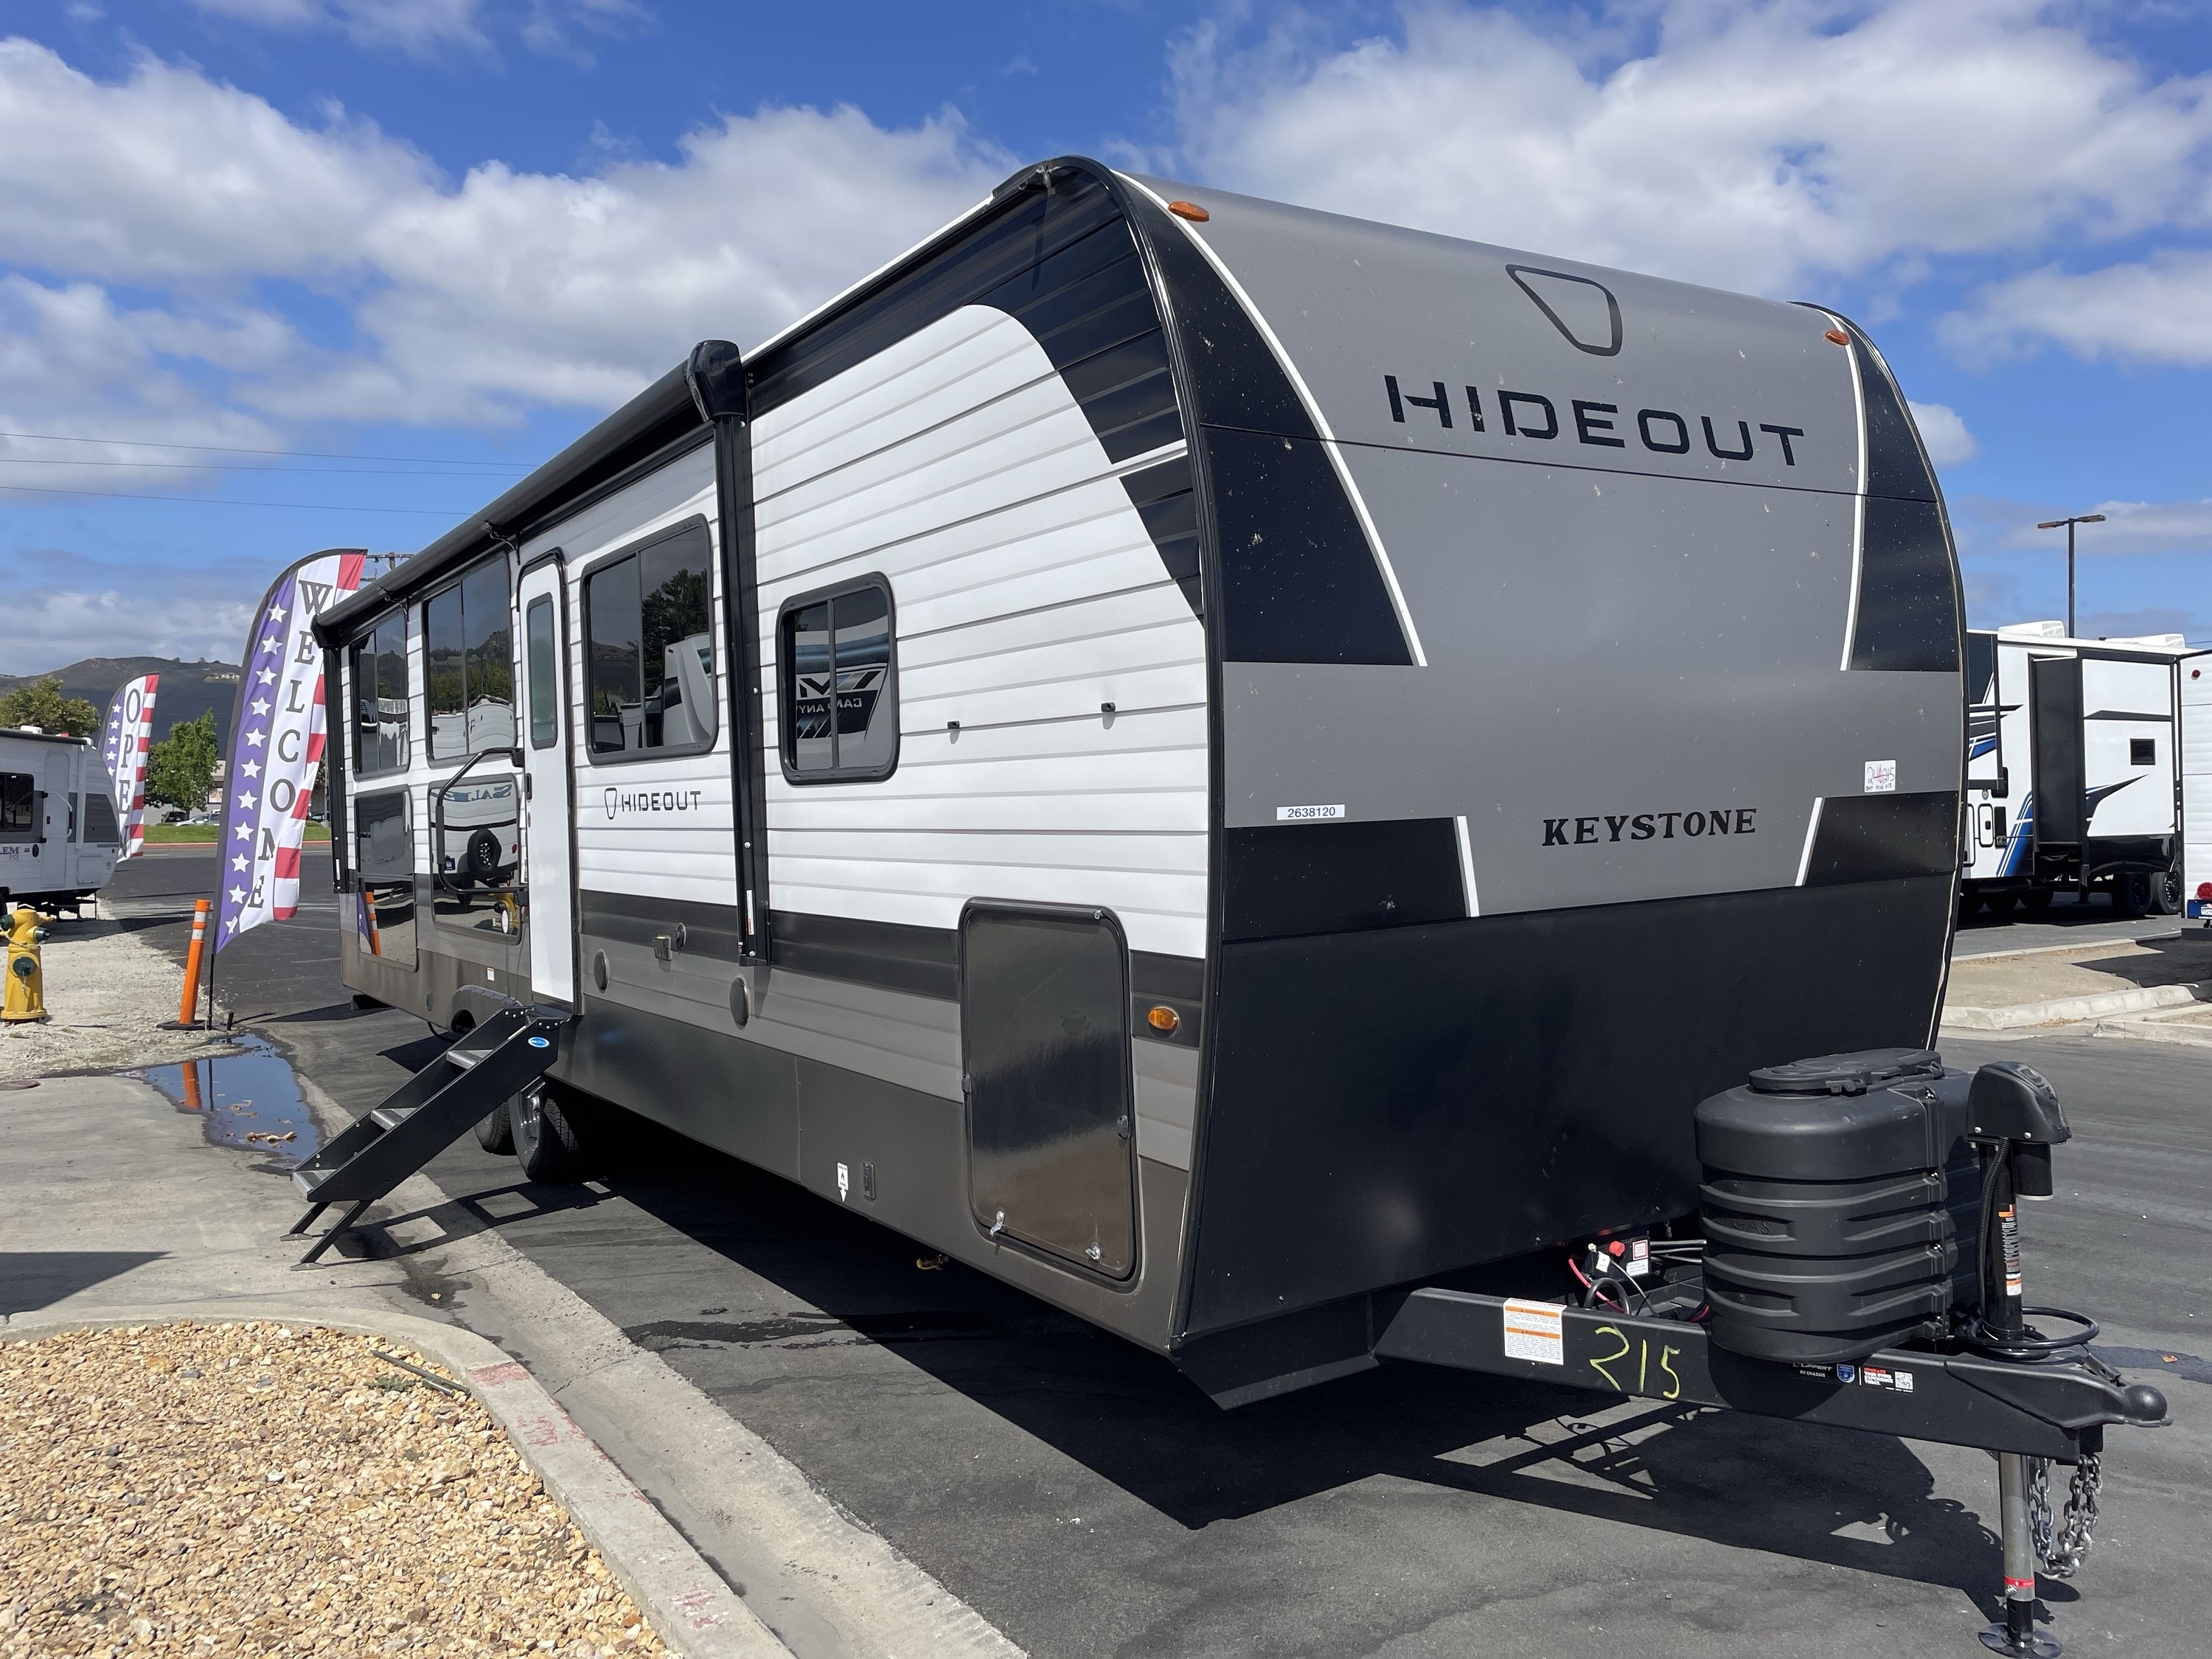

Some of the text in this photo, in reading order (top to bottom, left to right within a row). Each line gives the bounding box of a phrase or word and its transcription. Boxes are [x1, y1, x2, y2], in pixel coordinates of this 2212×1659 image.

[1384, 375, 1804, 466] HIDEOUT
[622, 790, 701, 812] HIDEOUT
[1287, 807, 1335, 818] 2638120
[1542, 808, 1757, 846] KEYSTONE
[1590, 1326, 1680, 1399] 215
